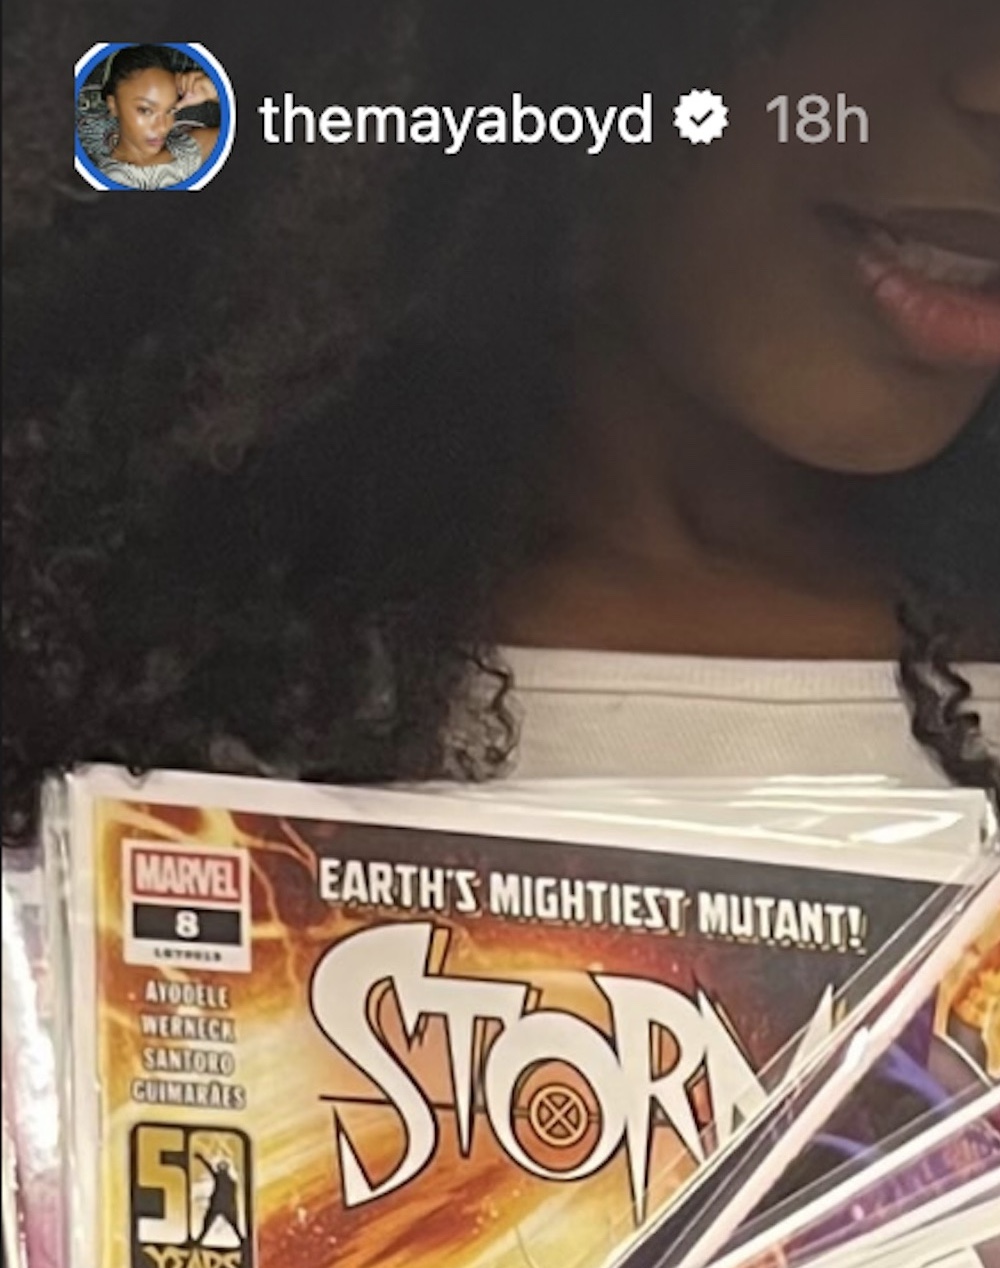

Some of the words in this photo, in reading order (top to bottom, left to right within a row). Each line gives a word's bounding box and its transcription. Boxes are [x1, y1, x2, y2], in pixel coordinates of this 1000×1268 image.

[135, 853, 239, 899] MARVEL
[318, 857, 482, 913] EARTH'S
[489, 871, 686, 932] MIGHTIEST
[699, 893, 868, 948] MUTANT!
[175, 909, 200, 939] 8
[145, 981, 229, 1009] AYODELE
[140, 1015, 237, 1044] WERNECK
[142, 1046, 236, 1077] SANTORO
